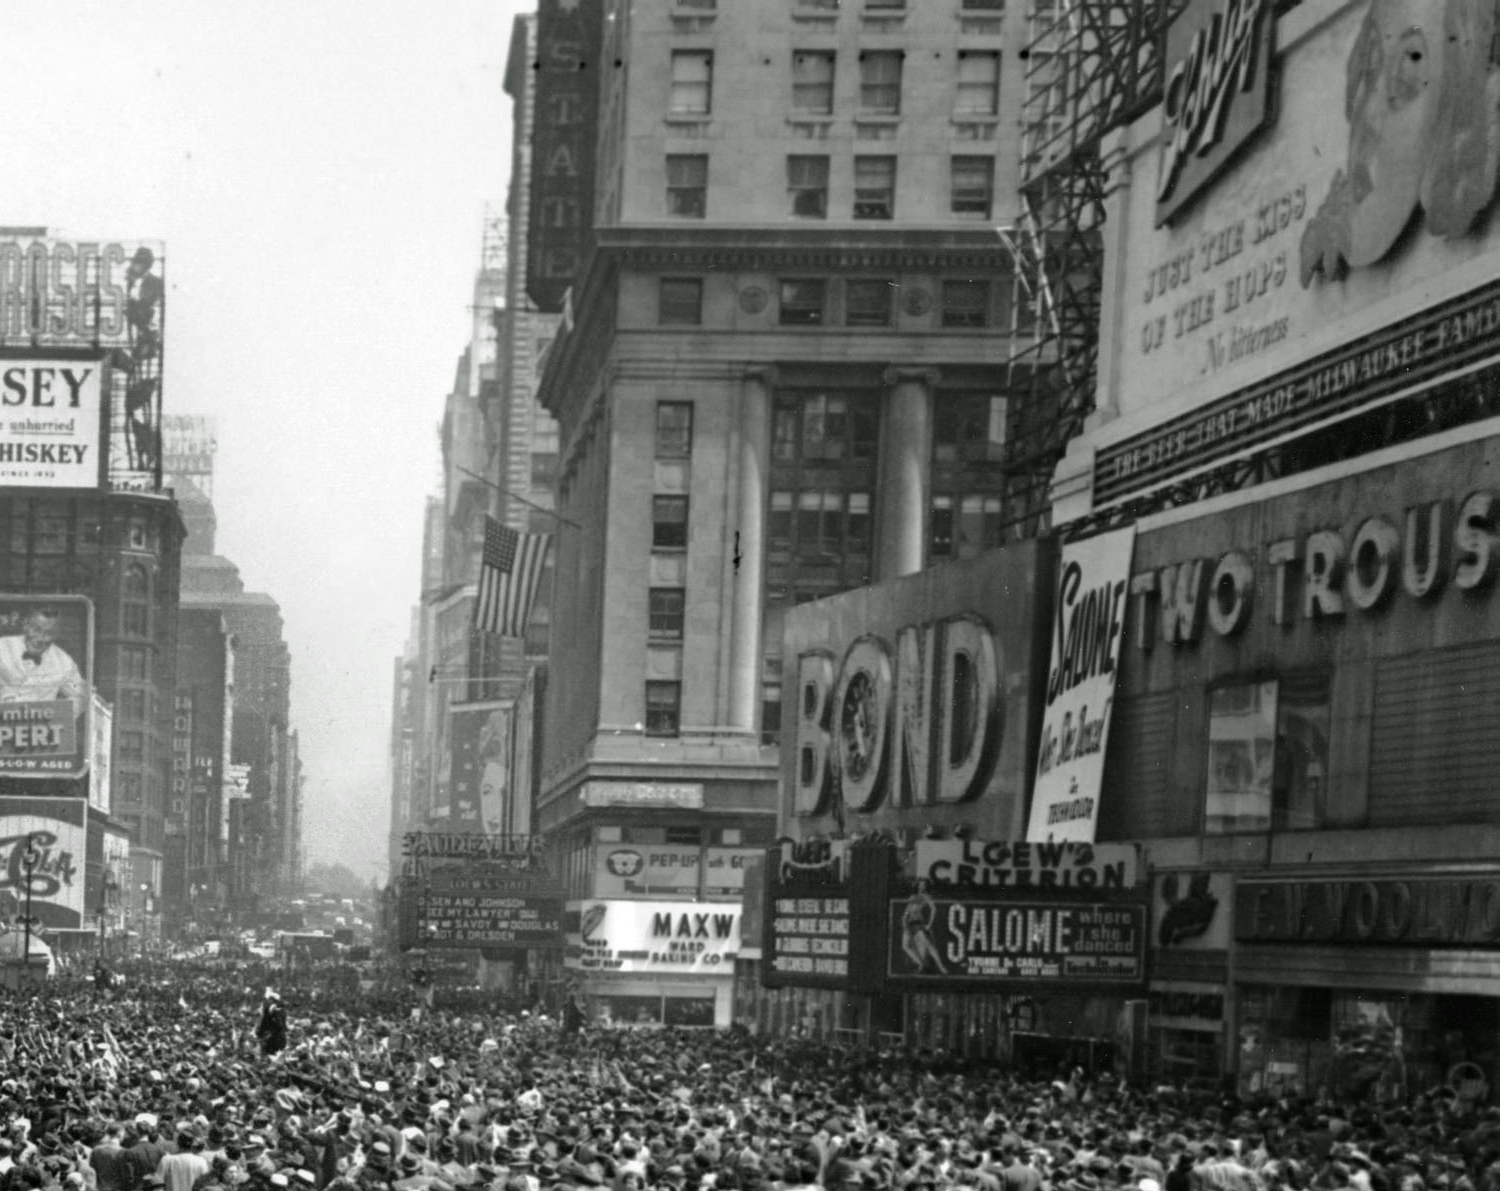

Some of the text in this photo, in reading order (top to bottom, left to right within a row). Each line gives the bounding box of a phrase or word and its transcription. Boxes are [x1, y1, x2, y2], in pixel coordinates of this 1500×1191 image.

[1143, 248, 1195, 304] JUST
[1201, 219, 1245, 272] THE
[0, 241, 127, 337] ROSES
[1142, 251, 1287, 355] OF THE HOPS
[10, 418, 76, 431] unhurried
[1130, 491, 1497, 649] TWO TROUS
[3, 706, 56, 720] mine
[794, 612, 1000, 817] BOND
[40, 760, 73, 769] AGED
[929, 860, 1126, 888] CRITERION
[418, 896, 454, 907] OSEN
[455, 897, 476, 907] AND
[447, 908, 463, 918] MY
[1078, 907, 1132, 925] where
[455, 919, 492, 929] SAVOY
[510, 920, 560, 931] DOUGLAS
[653, 911, 734, 939] MAXW
[947, 903, 1072, 963] SALOME
[1091, 924, 1121, 941] she
[418, 930, 452, 940] CBOT
[456, 930, 464, 940] &
[1073, 929, 1134, 952] danced
[669, 941, 706, 953] WARD
[651, 952, 697, 965] BAKING
